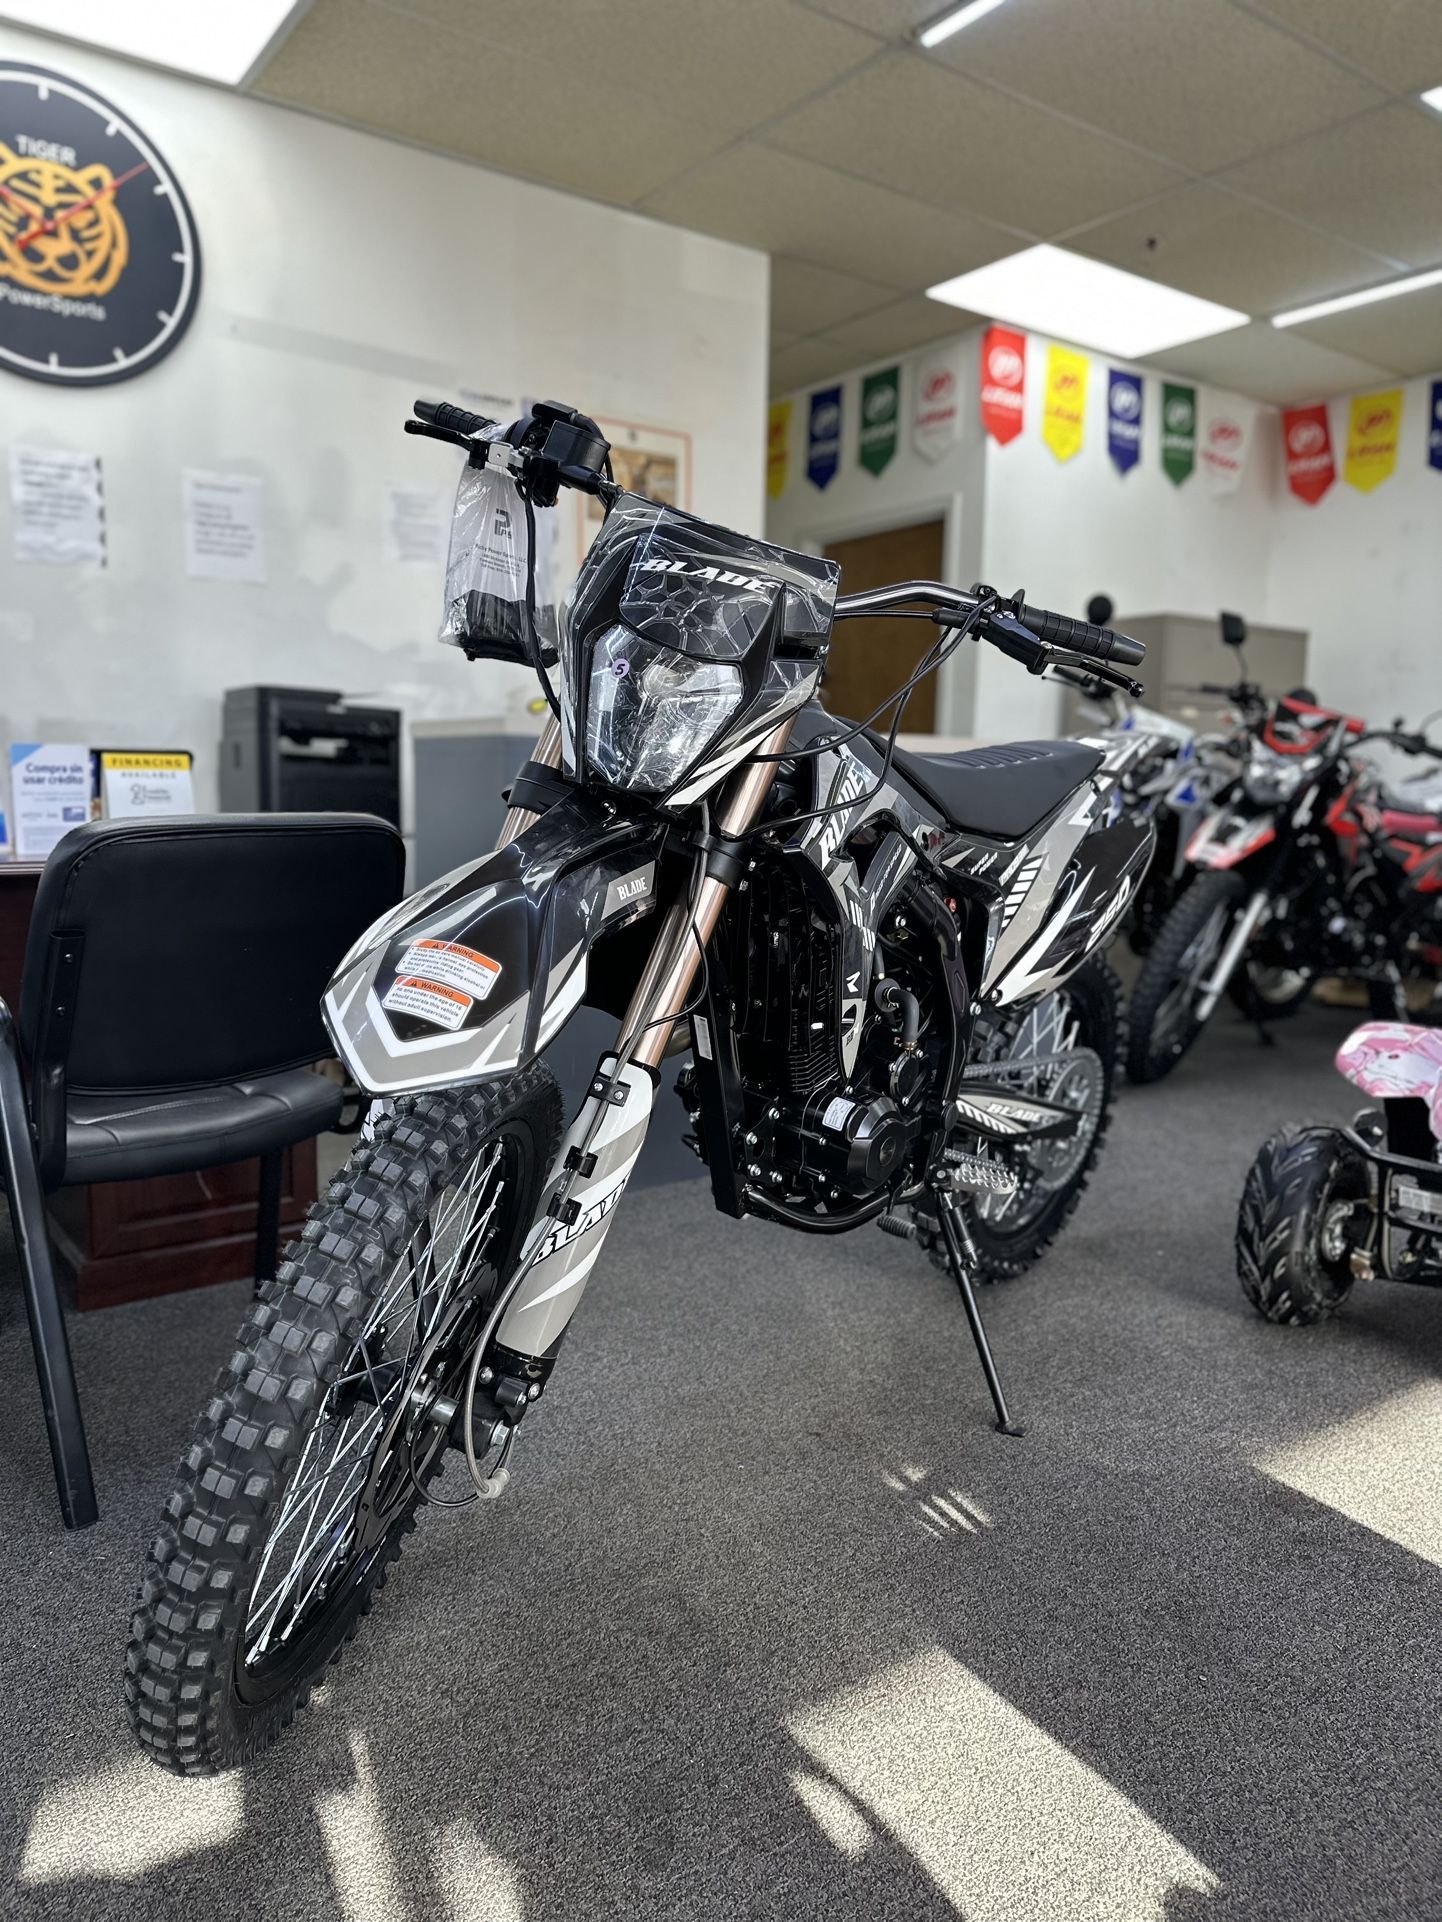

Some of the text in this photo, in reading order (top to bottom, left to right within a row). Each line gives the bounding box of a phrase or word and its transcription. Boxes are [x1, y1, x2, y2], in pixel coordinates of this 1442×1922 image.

[641, 558, 776, 595] BLADE
[614, 664, 626, 676] 5
[26, 763, 84, 774] Compra sin
[112, 757, 183, 767] FINANCING
[23, 776, 46, 785] usar
[617, 877, 648, 901] BLADE
[1085, 874, 1131, 953] 250
[421, 981, 455, 998] WARNING
[388, 998, 407, 1007] without
[429, 993, 439, 1001] the
[391, 992, 409, 1000] should
[429, 1001, 440, 1009] this
[440, 1006, 459, 1017] vehicle
[530, 1179, 625, 1268] BLAD
